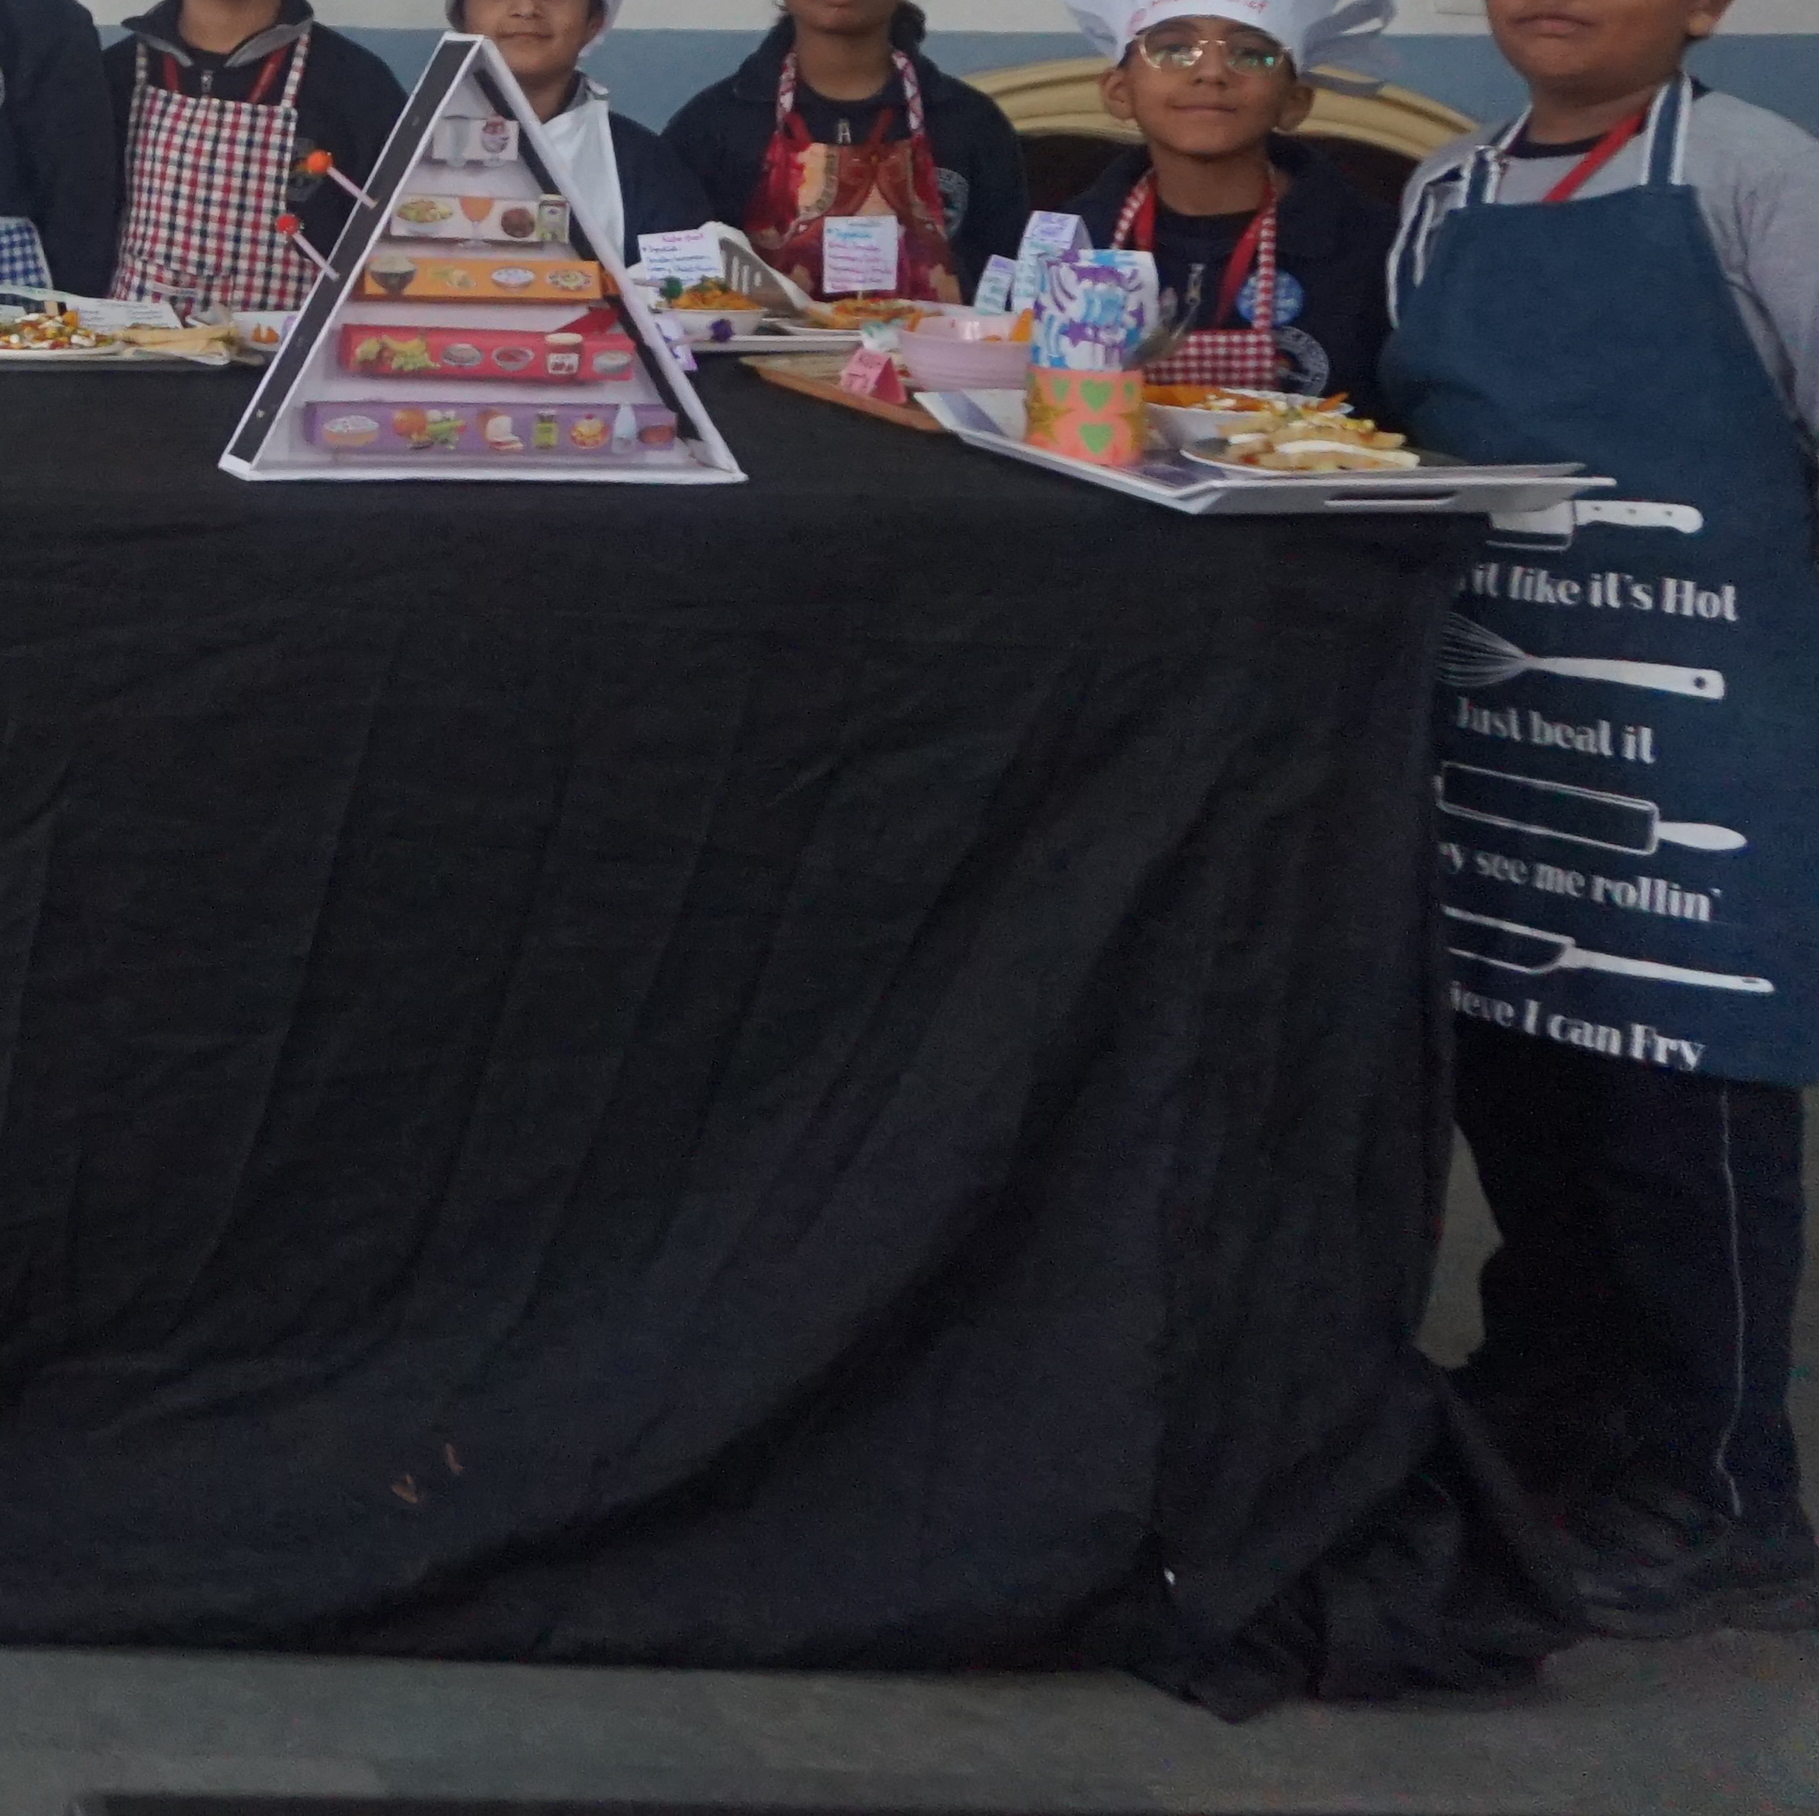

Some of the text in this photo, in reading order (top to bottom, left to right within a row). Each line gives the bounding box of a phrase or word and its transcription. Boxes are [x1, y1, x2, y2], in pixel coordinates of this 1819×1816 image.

[1471, 562, 1500, 598] it
[1508, 565, 1581, 605] like
[1588, 571, 1653, 611] it's
[1662, 576, 1739, 622] Hot
[1457, 695, 1657, 765] Just beat it
[1474, 850, 1528, 885] see
[1534, 862, 1586, 898] me
[1590, 875, 1723, 923] rollin'
[1523, 998, 1542, 1035] I
[1546, 1014, 1621, 1057] can
[1630, 1023, 1707, 1072] Fry
